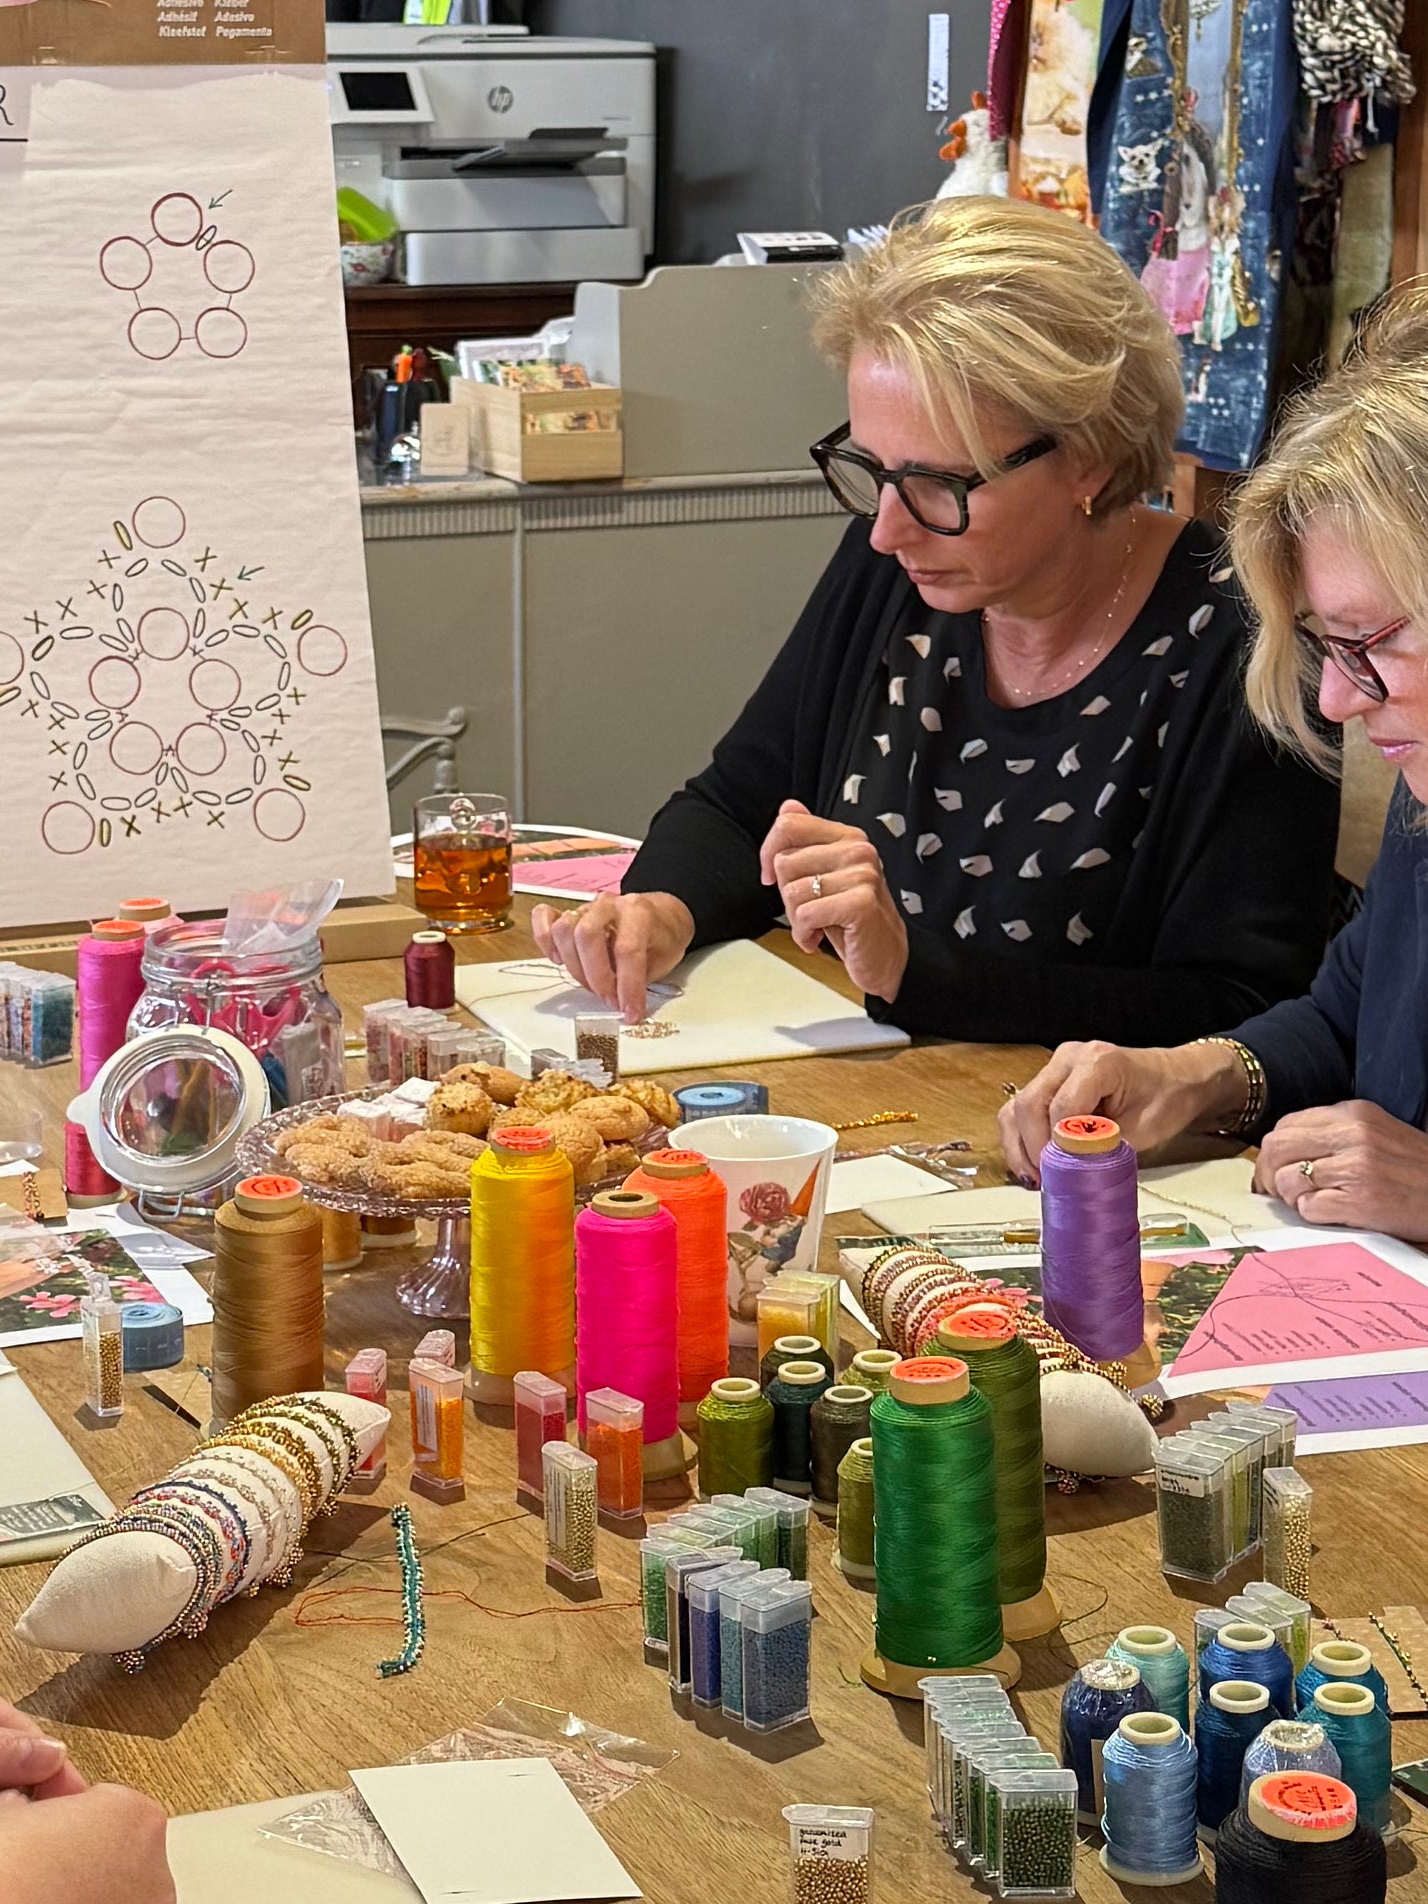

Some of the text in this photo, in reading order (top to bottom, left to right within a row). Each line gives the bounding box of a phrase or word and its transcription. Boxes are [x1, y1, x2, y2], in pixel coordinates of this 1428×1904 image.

[214, 11, 255, 22] Adesivo
[159, 26, 273, 39] Kleefstof Pegamento
